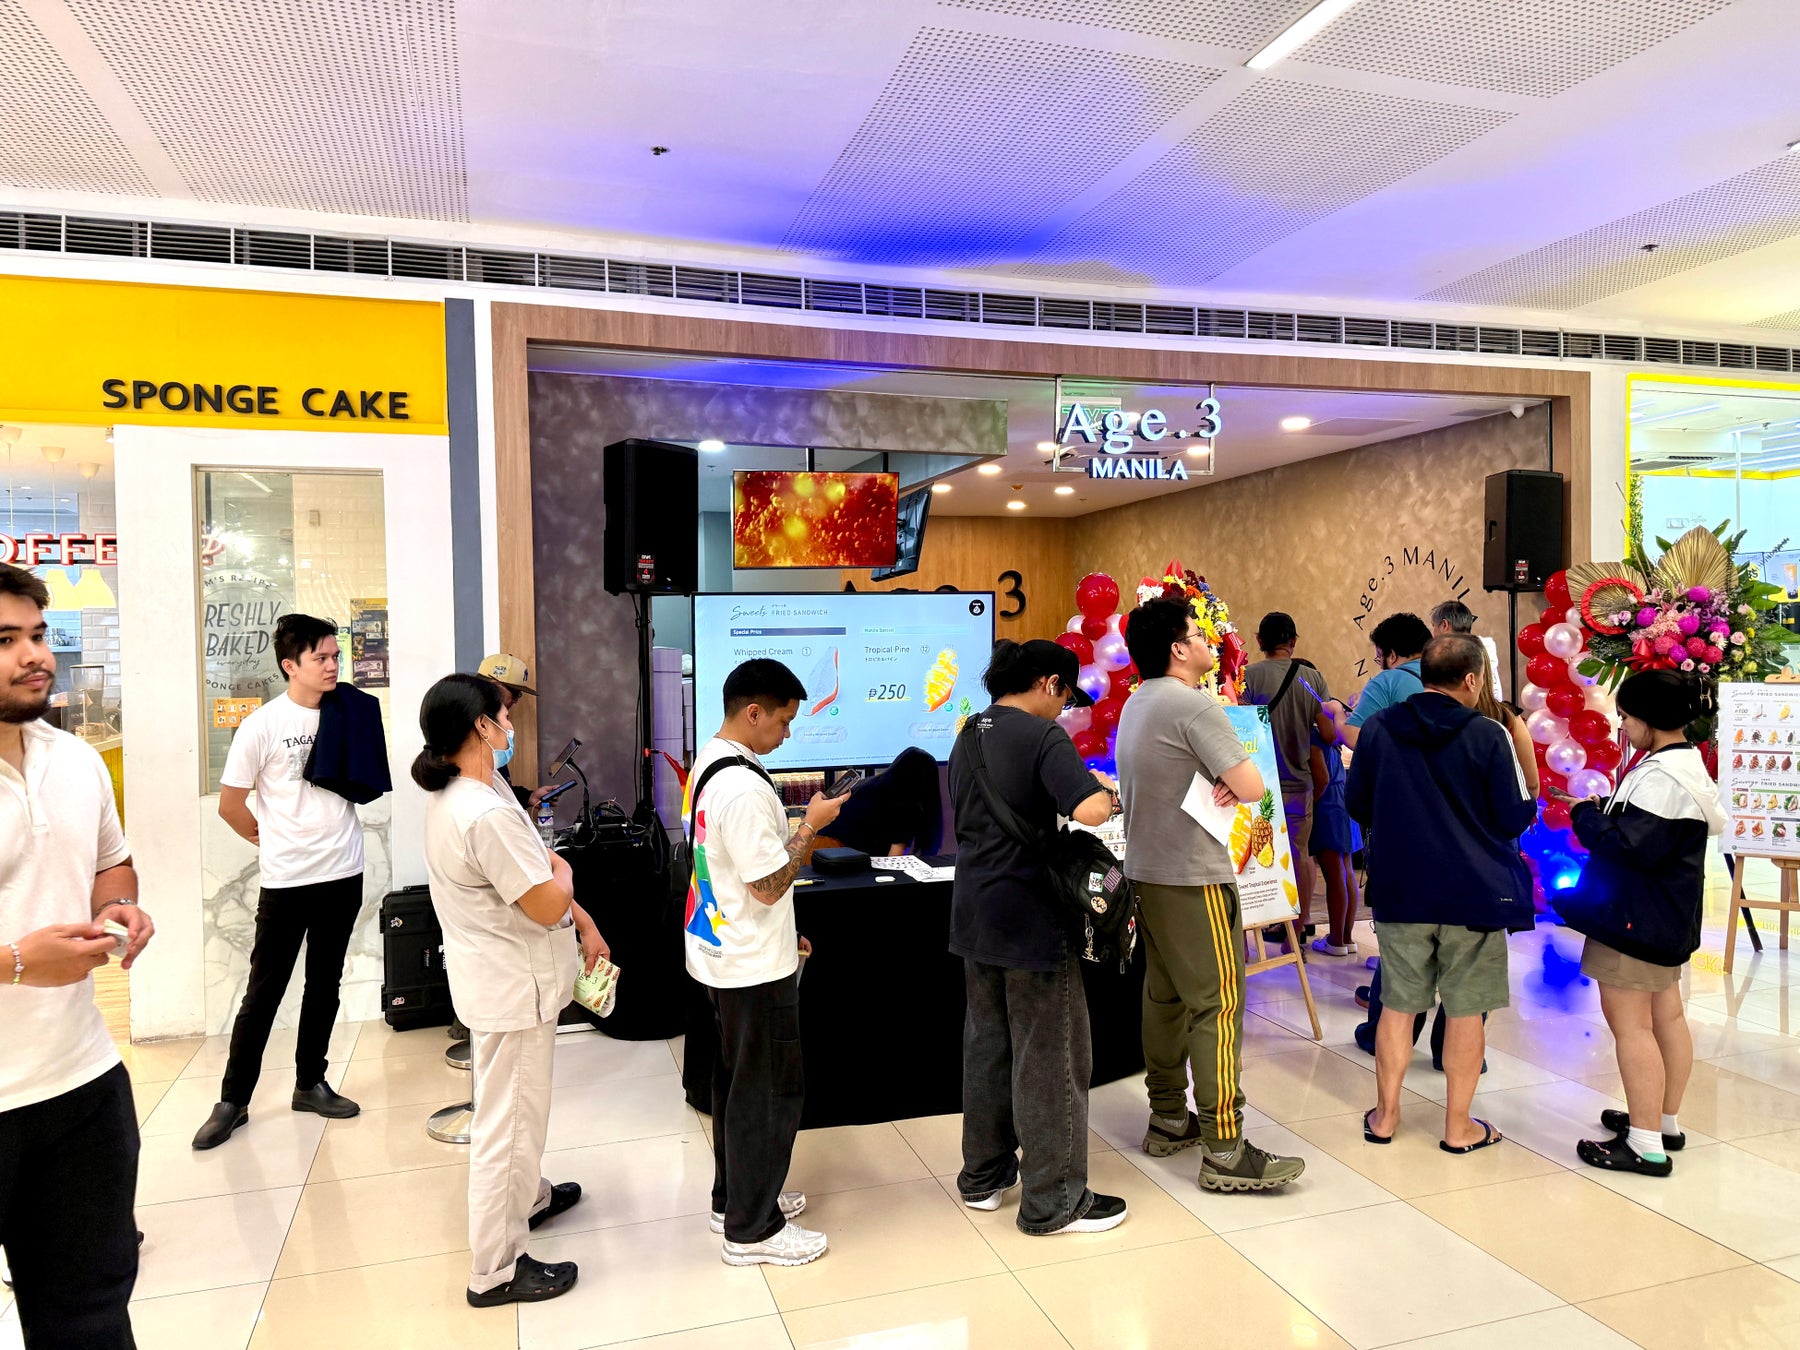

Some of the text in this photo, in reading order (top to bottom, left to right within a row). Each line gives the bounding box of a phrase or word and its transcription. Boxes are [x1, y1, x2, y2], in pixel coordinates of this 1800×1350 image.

[102, 379, 410, 419] SPONGE CAKE
[1060, 397, 1222, 454] Age.3
[1089, 457, 1189, 480] MANILA
[0, 533, 117, 566] OFFE
[204, 575, 225, 588] M'S
[1404, 546, 1478, 624] MANIL
[204, 601, 282, 628] RESHLY
[793, 608, 828, 616] SANDWICH
[206, 630, 270, 657] BAKED
[734, 648, 767, 657] Whipped
[768, 648, 793, 656] Cream
[865, 646, 893, 654] Tropical
[894, 645, 910, 653] Pine
[206, 672, 280, 691] PONGE CAKES
